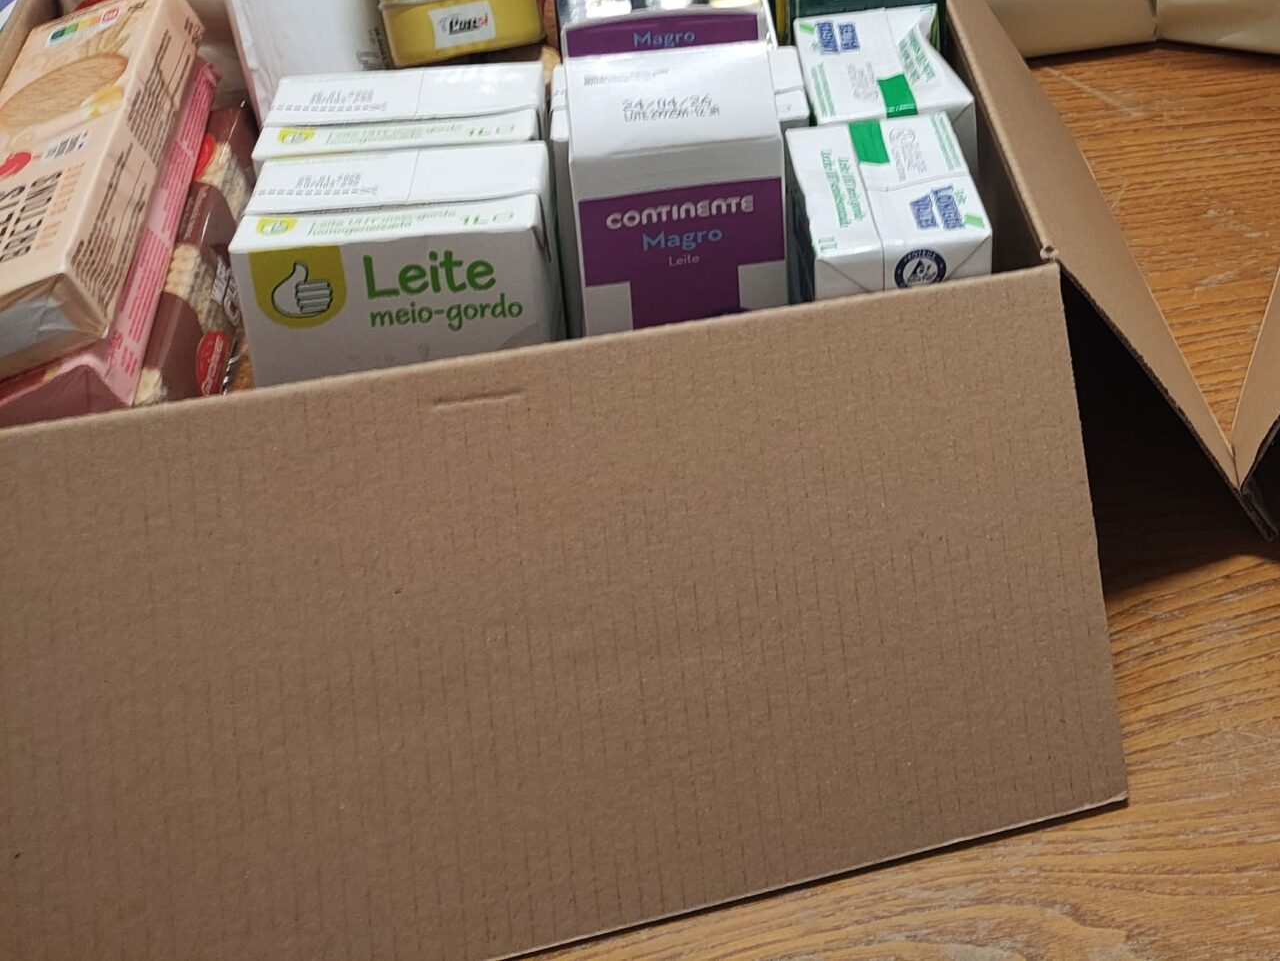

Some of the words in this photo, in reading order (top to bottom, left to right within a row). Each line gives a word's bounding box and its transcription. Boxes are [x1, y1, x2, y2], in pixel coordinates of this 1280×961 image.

[633, 30, 695, 49] Magro
[606, 194, 755, 230] CONTINENTE
[642, 227, 723, 252] Magro
[362, 249, 497, 300] Leite
[669, 253, 700, 268] Leite
[370, 294, 524, 331] meio-gordo
